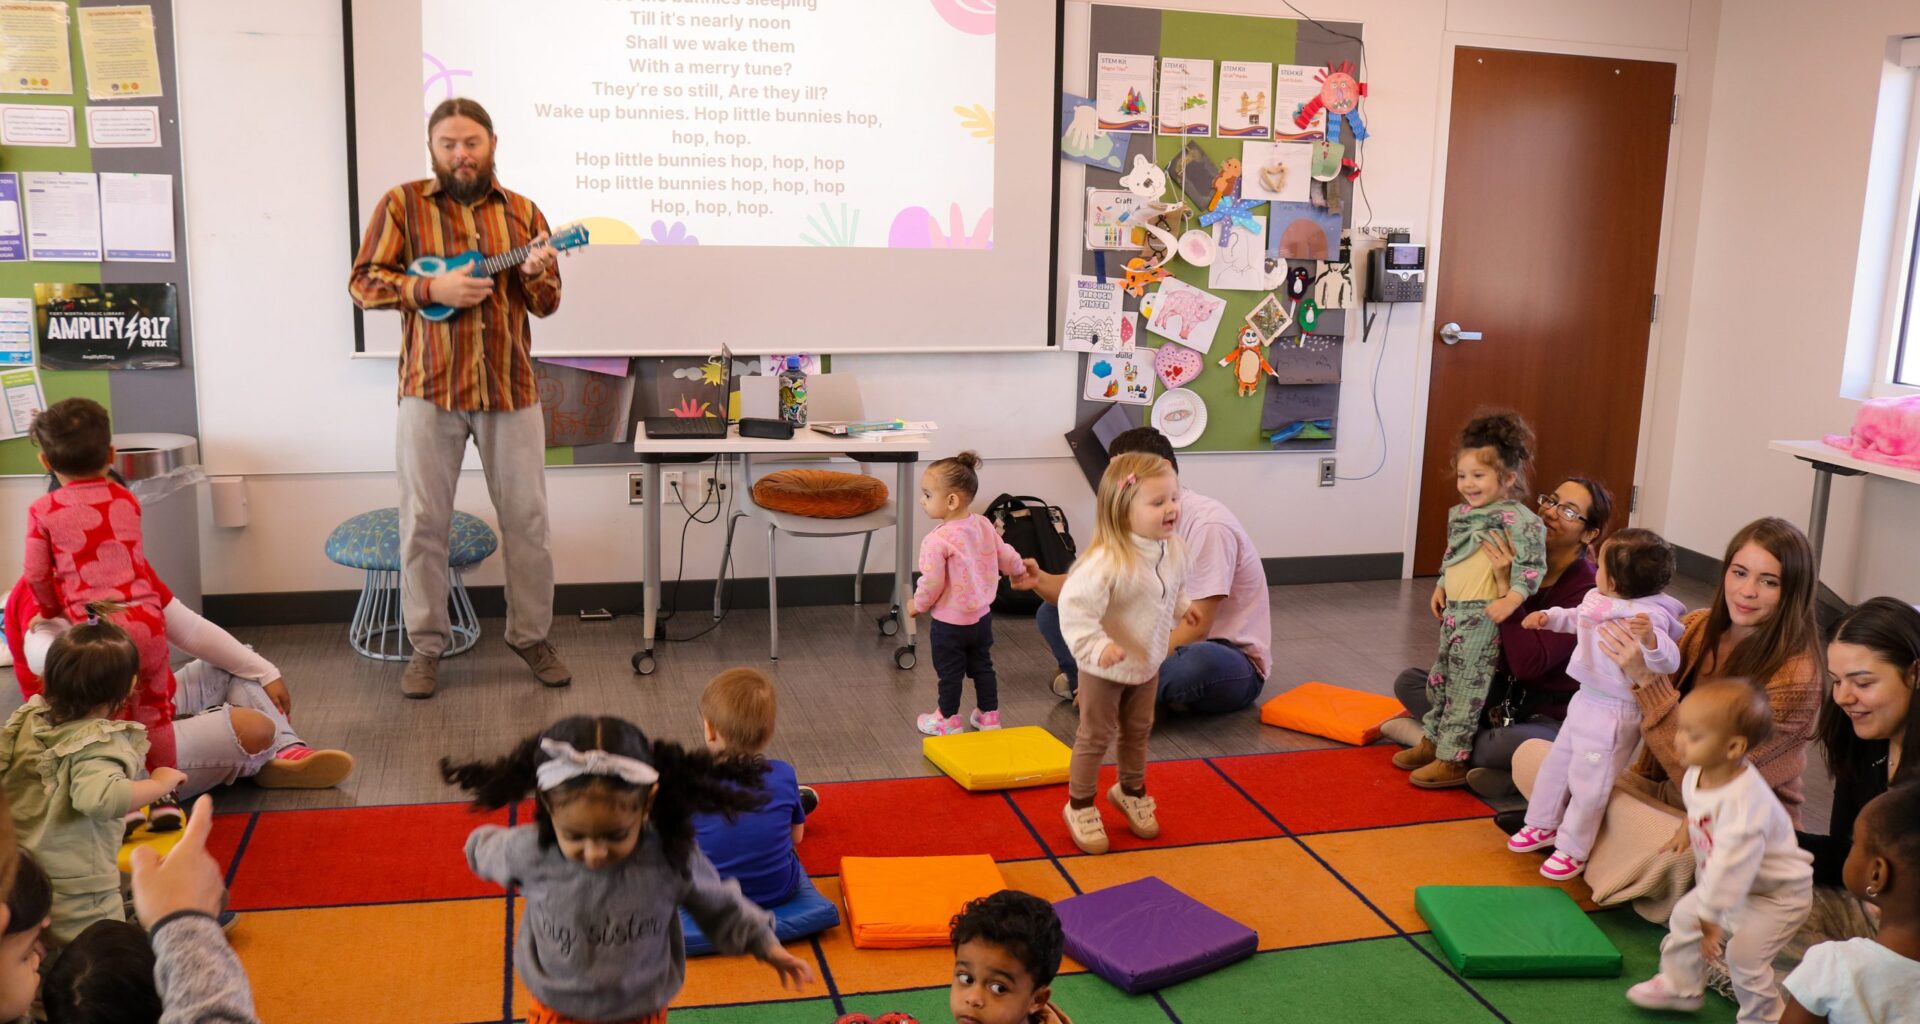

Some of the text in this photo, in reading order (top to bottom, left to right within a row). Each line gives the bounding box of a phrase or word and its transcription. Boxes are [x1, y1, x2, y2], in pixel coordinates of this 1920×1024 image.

[630, 11, 791, 32] Till it's nearly noon
[626, 35, 795, 54] Shall we wake them
[629, 59, 793, 79] With a merry tune?
[592, 81, 829, 104] They're so still, Are they ill?
[534, 104, 883, 129] Wake up bunnies. Hop little bunnies hop,
[672, 130, 751, 149] hop, hop.
[576, 152, 846, 174] Hop little bunnies hop, hop, hop
[576, 176, 846, 197] Hop little bunnies hop, hop, hop
[651, 199, 774, 219] Hop, hop, hop.
[1115, 197, 1132, 205] Craft
[1357, 227, 1410, 235] 118 STORAGE
[1077, 280, 1115, 290] WADDLING
[1078, 290, 1113, 300] THROUGH
[1079, 299, 1110, 309] WINTER
[48, 317, 125, 339] AMPLIFY
[139, 317, 171, 339] 817
[141, 340, 168, 348] FWTX
[588, 911, 663, 946] sister
